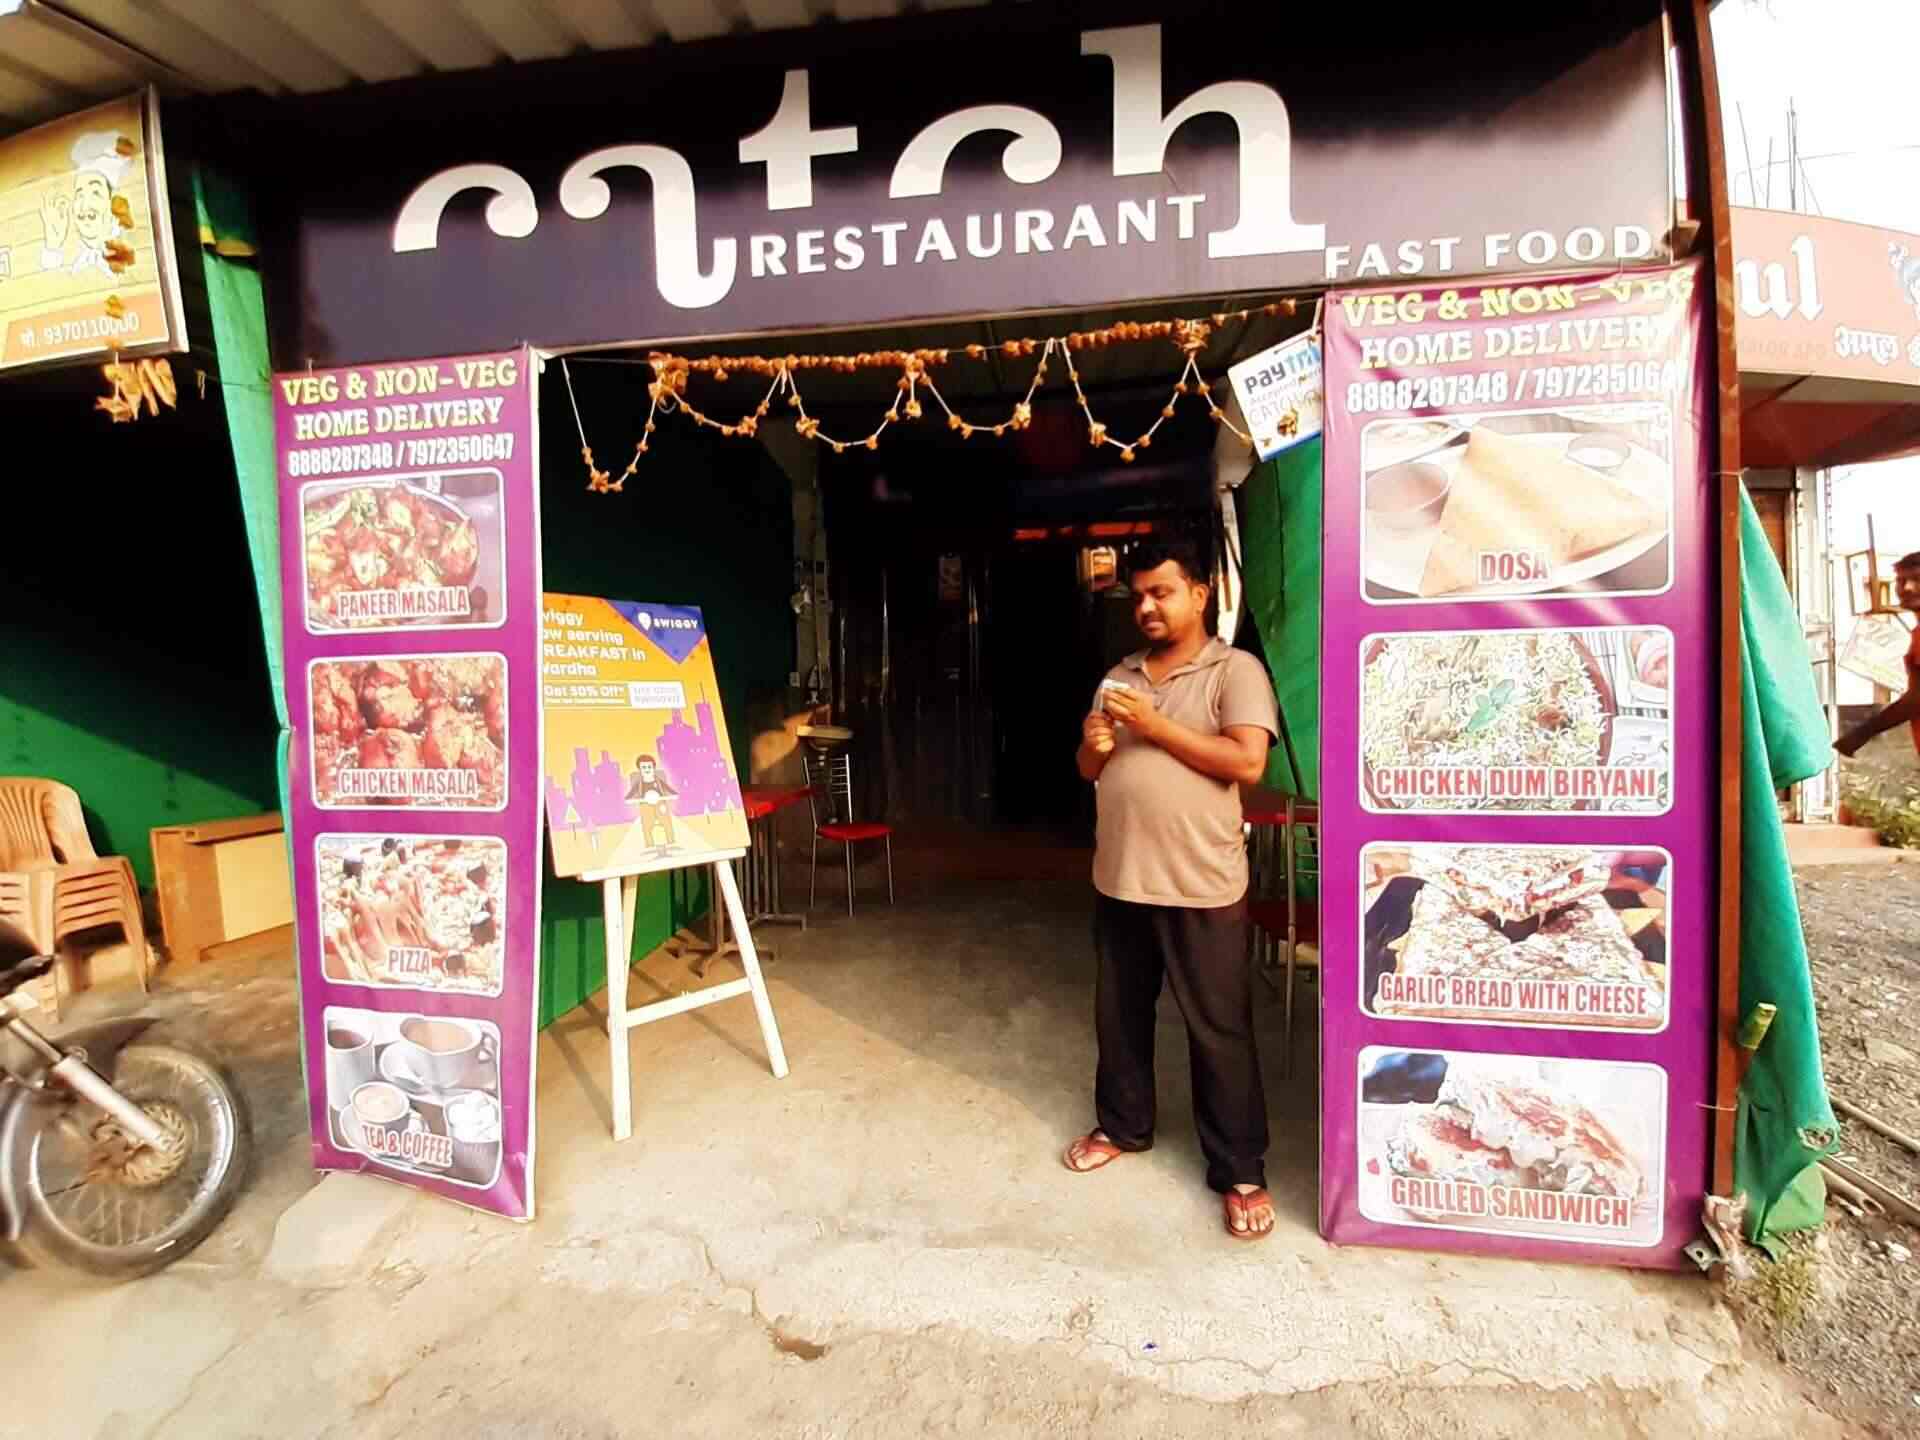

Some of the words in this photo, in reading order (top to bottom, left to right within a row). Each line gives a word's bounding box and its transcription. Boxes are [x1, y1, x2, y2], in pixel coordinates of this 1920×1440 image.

[750, 193, 1207, 279] RESTAURANT
[1325, 236, 1461, 280] FAST
[1484, 225, 1653, 268] FOOD
[1736, 235, 1824, 320] ul
[1342, 292, 1428, 328] VEG
[1438, 290, 1469, 321] &
[1360, 329, 1472, 370] HOME
[280, 376, 340, 407] VEG
[345, 372, 368, 400] &
[374, 358, 518, 398] NON-VEG
[1346, 370, 1509, 414] 8888287348
[294, 408, 370, 441] HOME
[374, 396, 505, 434] DELIVERY
[288, 442, 393, 478] 8888287348
[396, 441, 405, 468] /
[409, 433, 515, 466] 7972350647
[1480, 552, 1548, 581] DOSA
[340, 591, 398, 617] PANEER
[402, 588, 469, 614] MASALA
[543, 607, 584, 627] wiggy
[543, 629, 563, 641] ow
[653, 617, 699, 630] SWIGGY
[543, 644, 629, 661] REAKFAST
[340, 770, 407, 796] CHICKEN
[411, 770, 479, 795] MASALA
[1376, 768, 1483, 796] CHICKEN
[1489, 769, 1546, 796] DUM
[1554, 768, 1656, 797] BIRYANI
[388, 948, 432, 974] PIZZA
[1380, 974, 1446, 1005] GARLIC
[1450, 978, 1512, 1008] BREAD
[1518, 981, 1570, 1011] WITH
[1576, 984, 1647, 1014] CHEESE
[361, 1124, 385, 1151] TEA
[387, 1132, 399, 1153] &
[400, 1131, 451, 1166] COFFEE
[1391, 1179, 1485, 1213] GRILLED
[1492, 1186, 1629, 1227] SANDWICH
